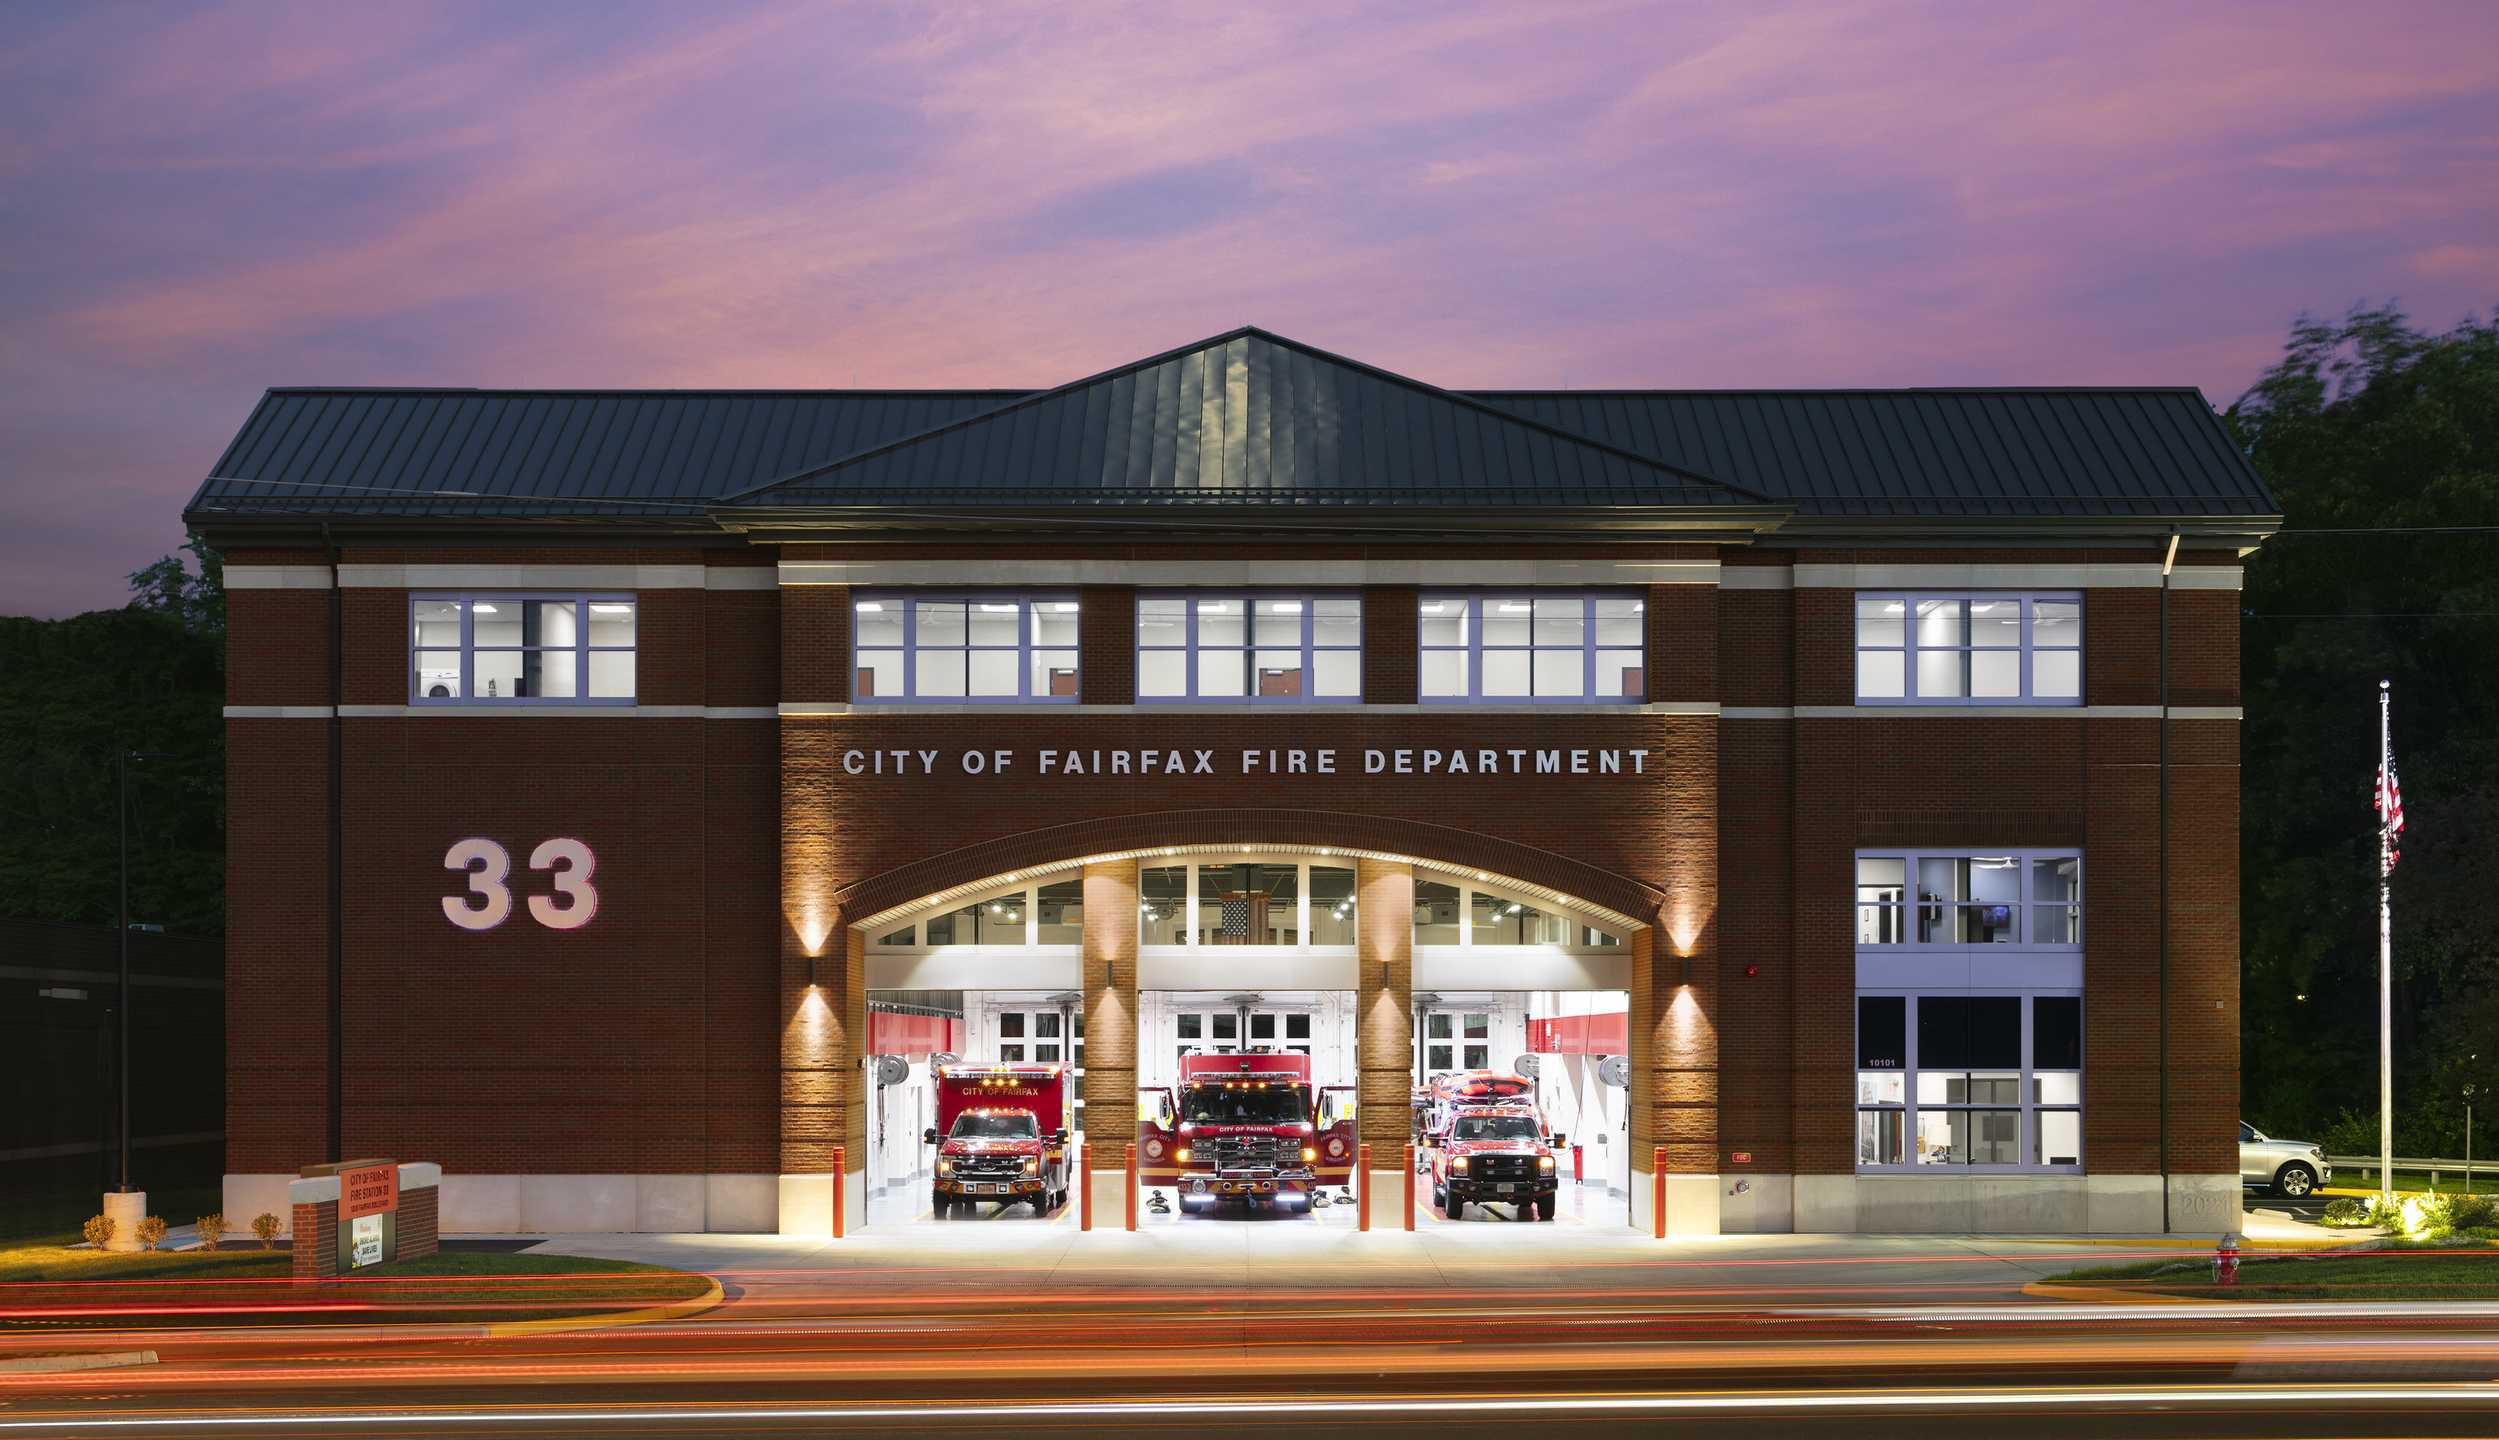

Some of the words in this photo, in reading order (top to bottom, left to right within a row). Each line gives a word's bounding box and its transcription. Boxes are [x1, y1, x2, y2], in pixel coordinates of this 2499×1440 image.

[843, 749, 938, 774] CITY
[962, 749, 1013, 774] OF
[1039, 749, 1214, 774] FAIRFAX
[1242, 749, 1336, 773] FIRE
[1365, 749, 1649, 773] DEPARTMENT
[441, 837, 598, 930] 33
[1870, 1058, 1896, 1067] 10101
[962, 1087, 983, 1096] CITY
[987, 1087, 999, 1096] OF
[1002, 1087, 1039, 1096] FAIRFAX
[350, 1174, 361, 1185] CITY
[350, 1189, 361, 1201] FIRE
